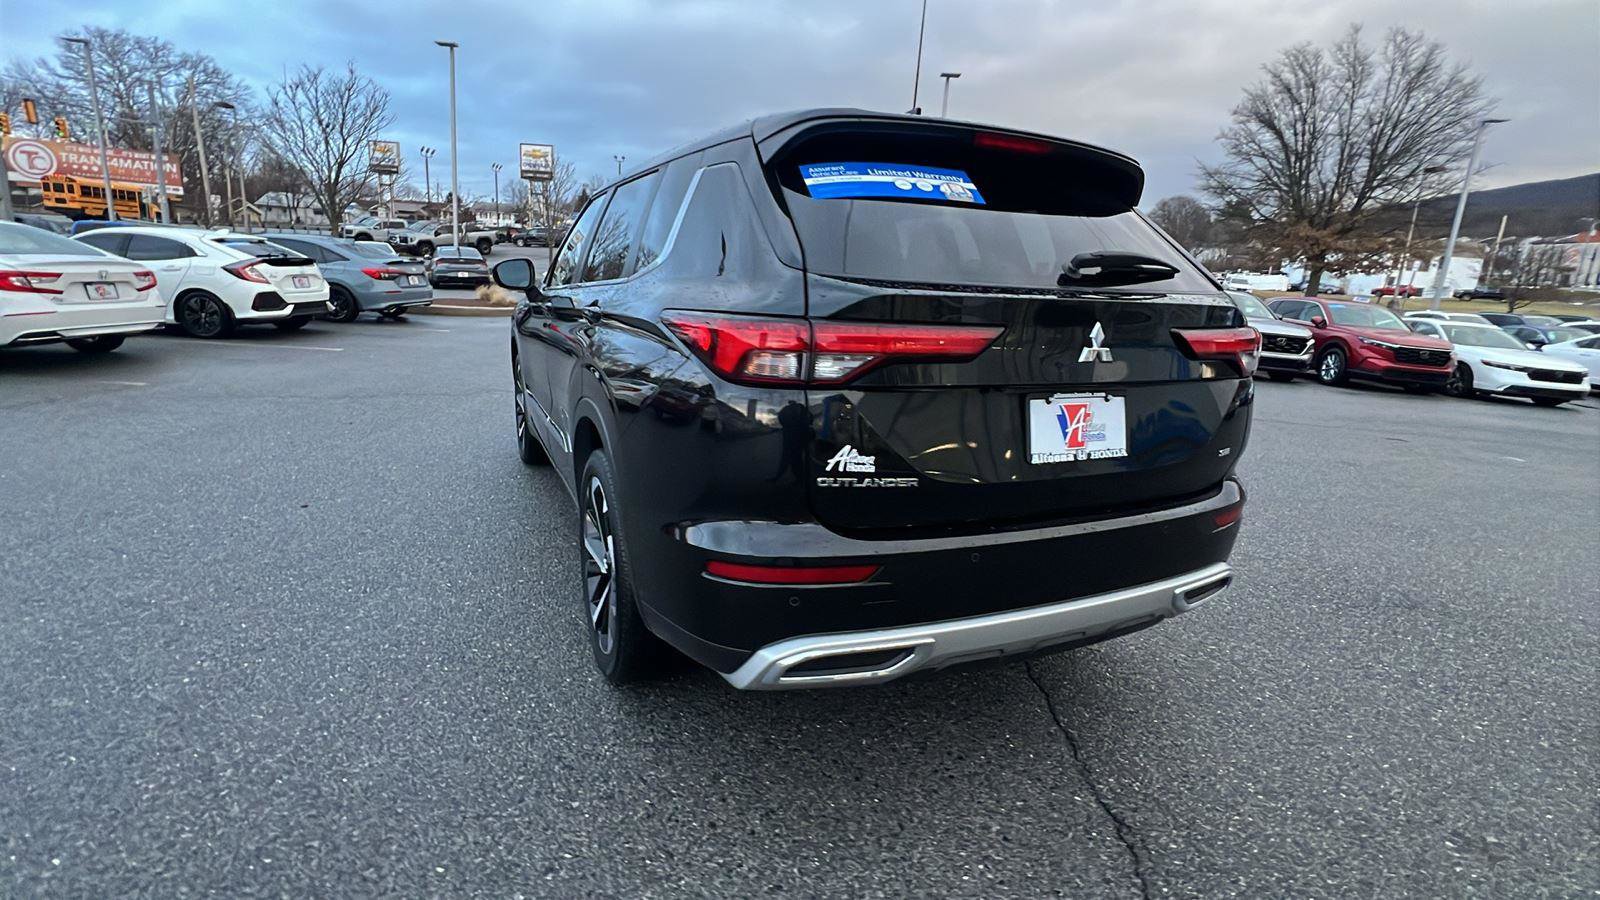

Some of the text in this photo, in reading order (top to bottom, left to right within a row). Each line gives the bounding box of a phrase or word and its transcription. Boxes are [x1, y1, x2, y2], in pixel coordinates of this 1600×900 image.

[19, 149, 47, 171] TC
[59, 152, 177, 173] TRAN4MATION
[867, 168, 963, 183] Limited Warranty
[1031, 452, 1075, 464] Altoona
[1090, 448, 1128, 459] HONDA
[816, 477, 919, 487] OUTLANDER
